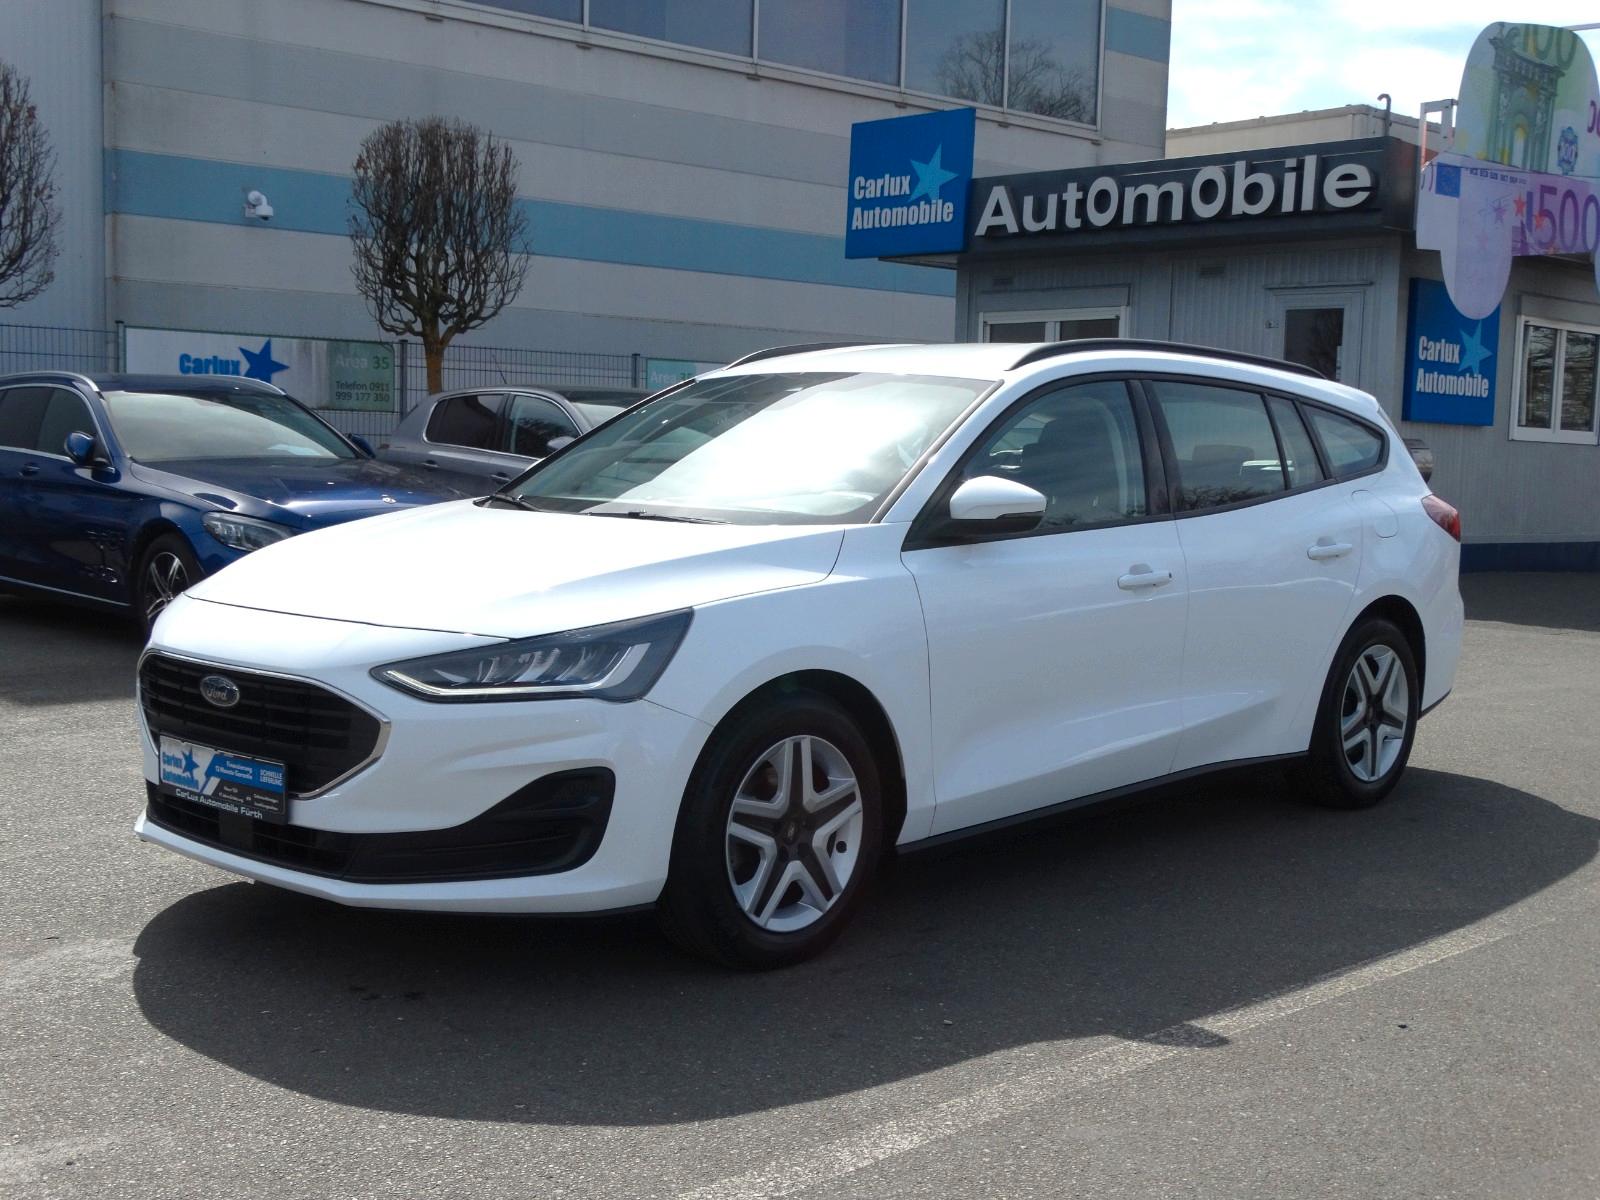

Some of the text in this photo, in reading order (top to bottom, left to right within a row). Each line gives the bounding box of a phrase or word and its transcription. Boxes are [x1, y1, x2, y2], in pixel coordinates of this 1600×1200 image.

[854, 174, 911, 199] Carlux
[851, 199, 954, 231] Automobile
[1418, 335, 1460, 364] Carlux
[179, 353, 241, 375] Carlux
[372, 355, 390, 370] 35
[335, 380, 367, 392] Telefon
[1416, 367, 1489, 398] Automobile
[355, 392, 370, 401] 177
[200, 795, 239, 813] Automobile
[240, 806, 263, 820] Fürth
